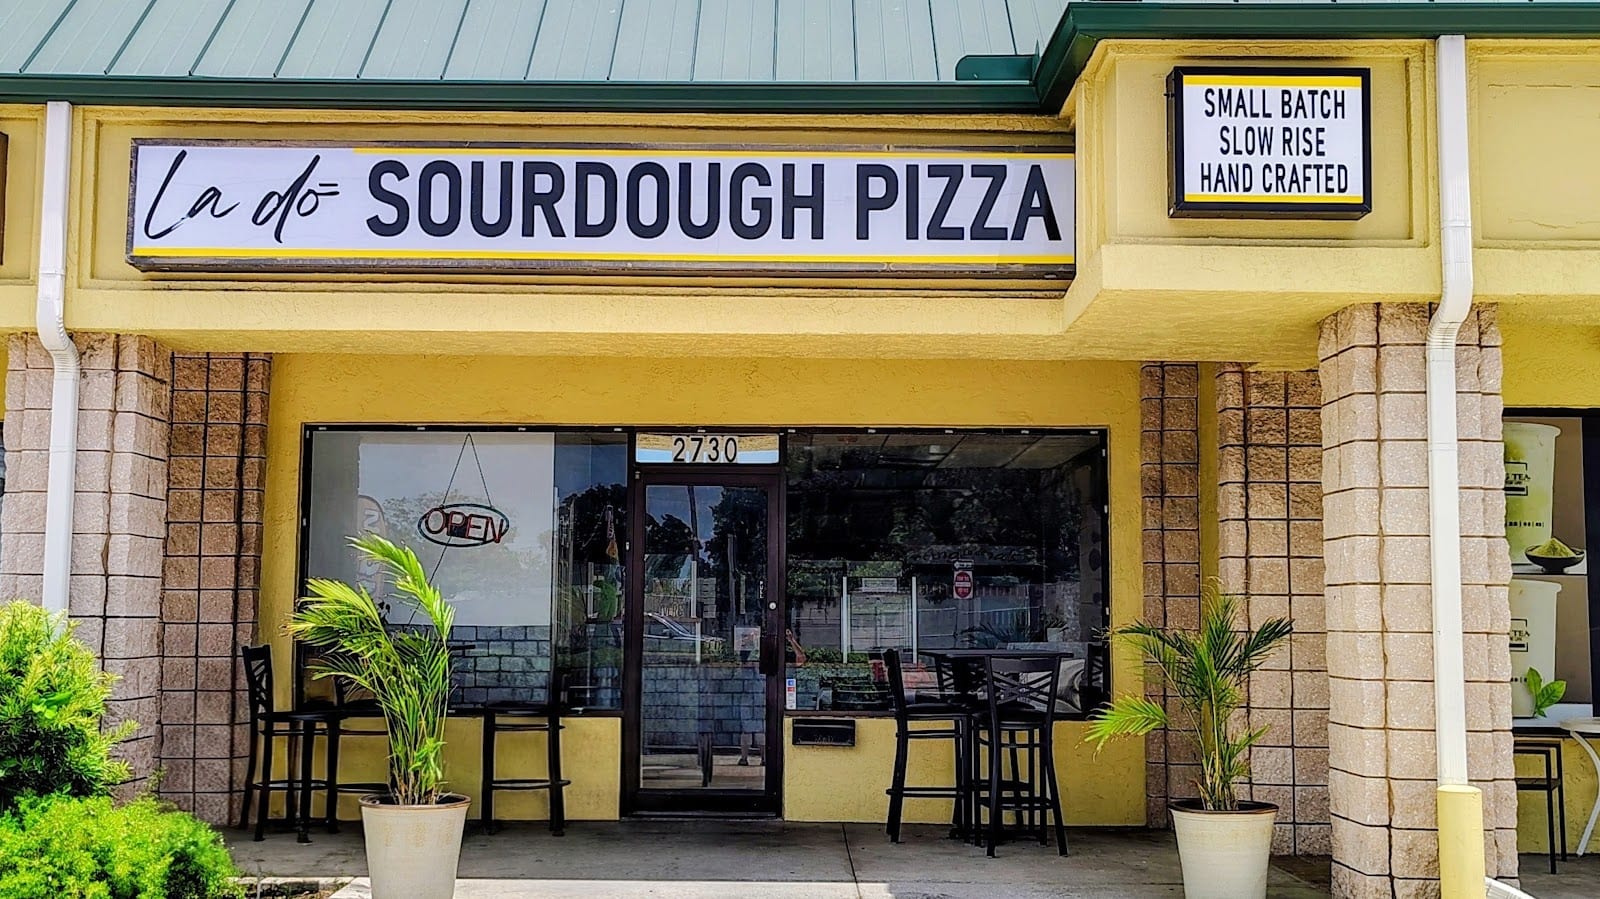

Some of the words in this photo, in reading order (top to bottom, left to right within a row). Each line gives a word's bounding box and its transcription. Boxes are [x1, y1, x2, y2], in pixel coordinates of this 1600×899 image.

[1204, 88, 1272, 119] SMALL
[1281, 89, 1346, 120] BATCH
[1219, 125, 1274, 156] SLOW
[1282, 127, 1326, 157] RISE
[1201, 163, 1253, 193] HAND
[1262, 163, 1348, 194] CRAFTED
[144, 150, 240, 240] La
[366, 160, 825, 240] SOURDOUGH
[855, 163, 1062, 242] PIZZA
[672, 437, 738, 463] 2730
[424, 507, 505, 544] OPEN
